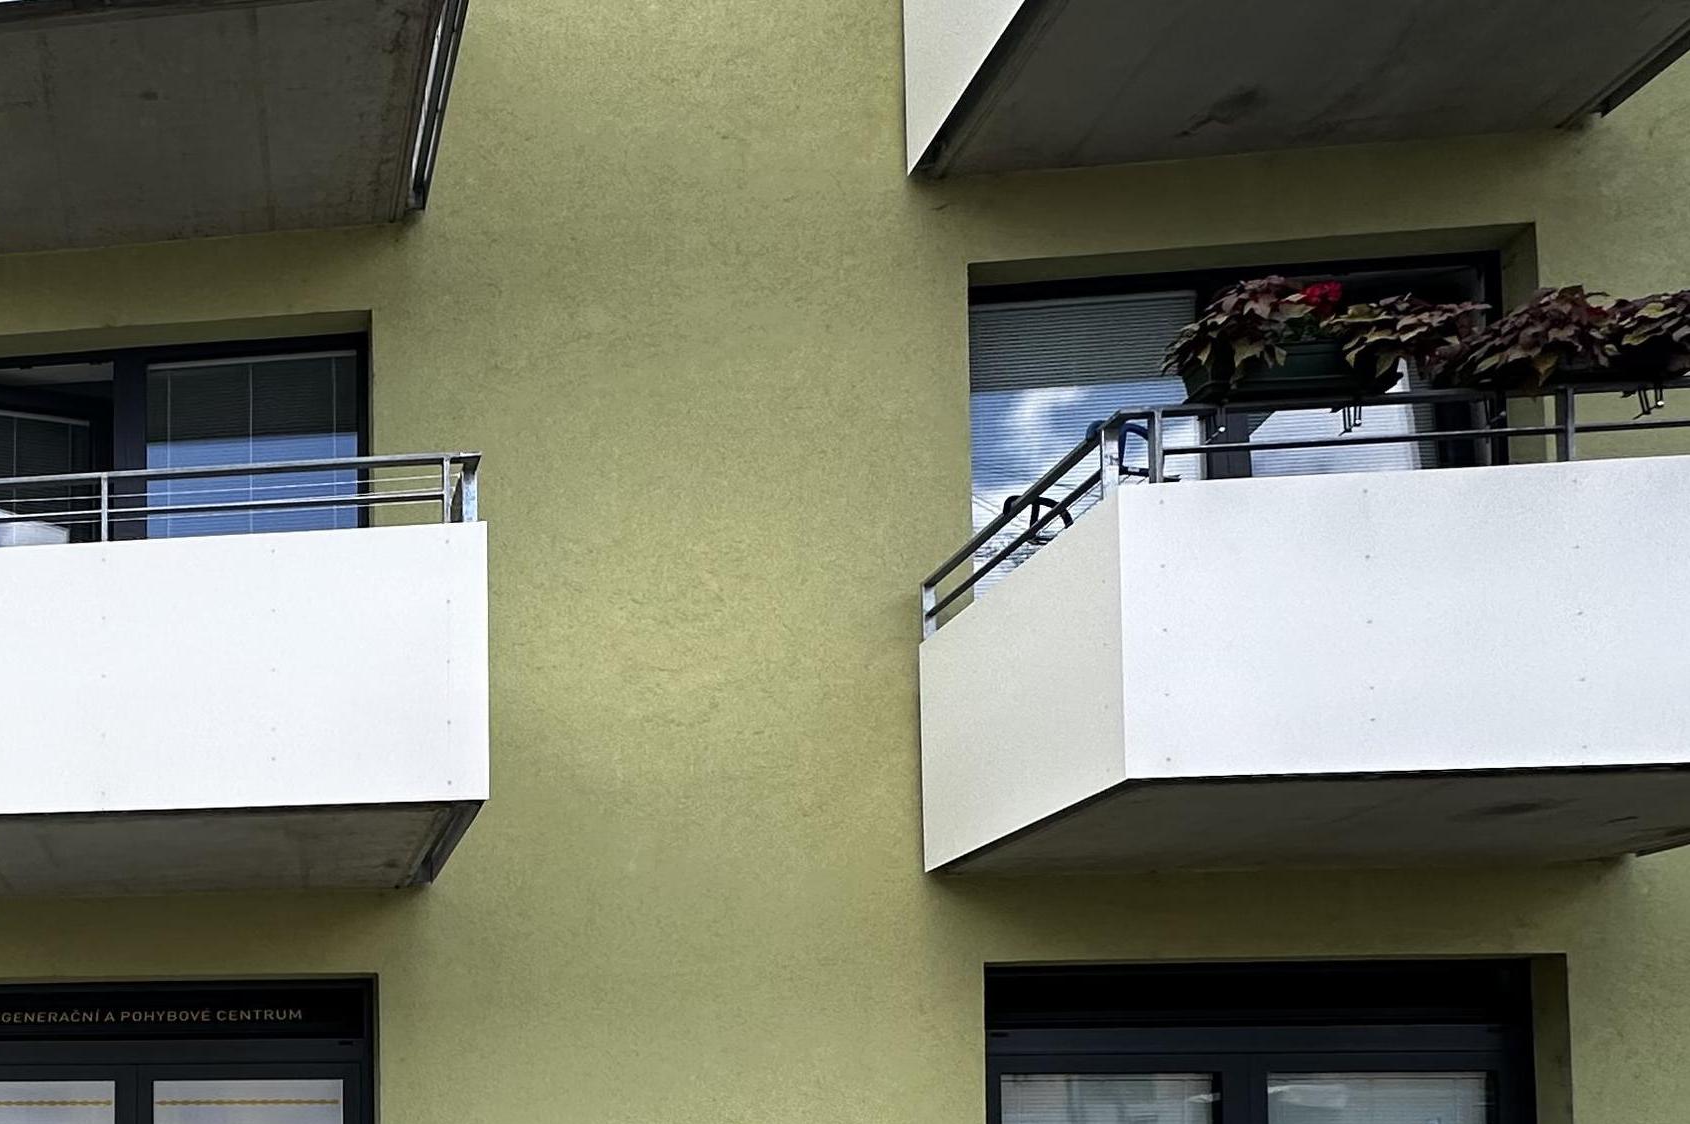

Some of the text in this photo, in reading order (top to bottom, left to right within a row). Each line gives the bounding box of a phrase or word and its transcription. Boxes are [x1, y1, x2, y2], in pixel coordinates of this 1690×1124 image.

[104, 1011, 115, 1023] A
[120, 1008, 211, 1022] POHYBOVÉ
[216, 1009, 303, 1021] CENTRUM
